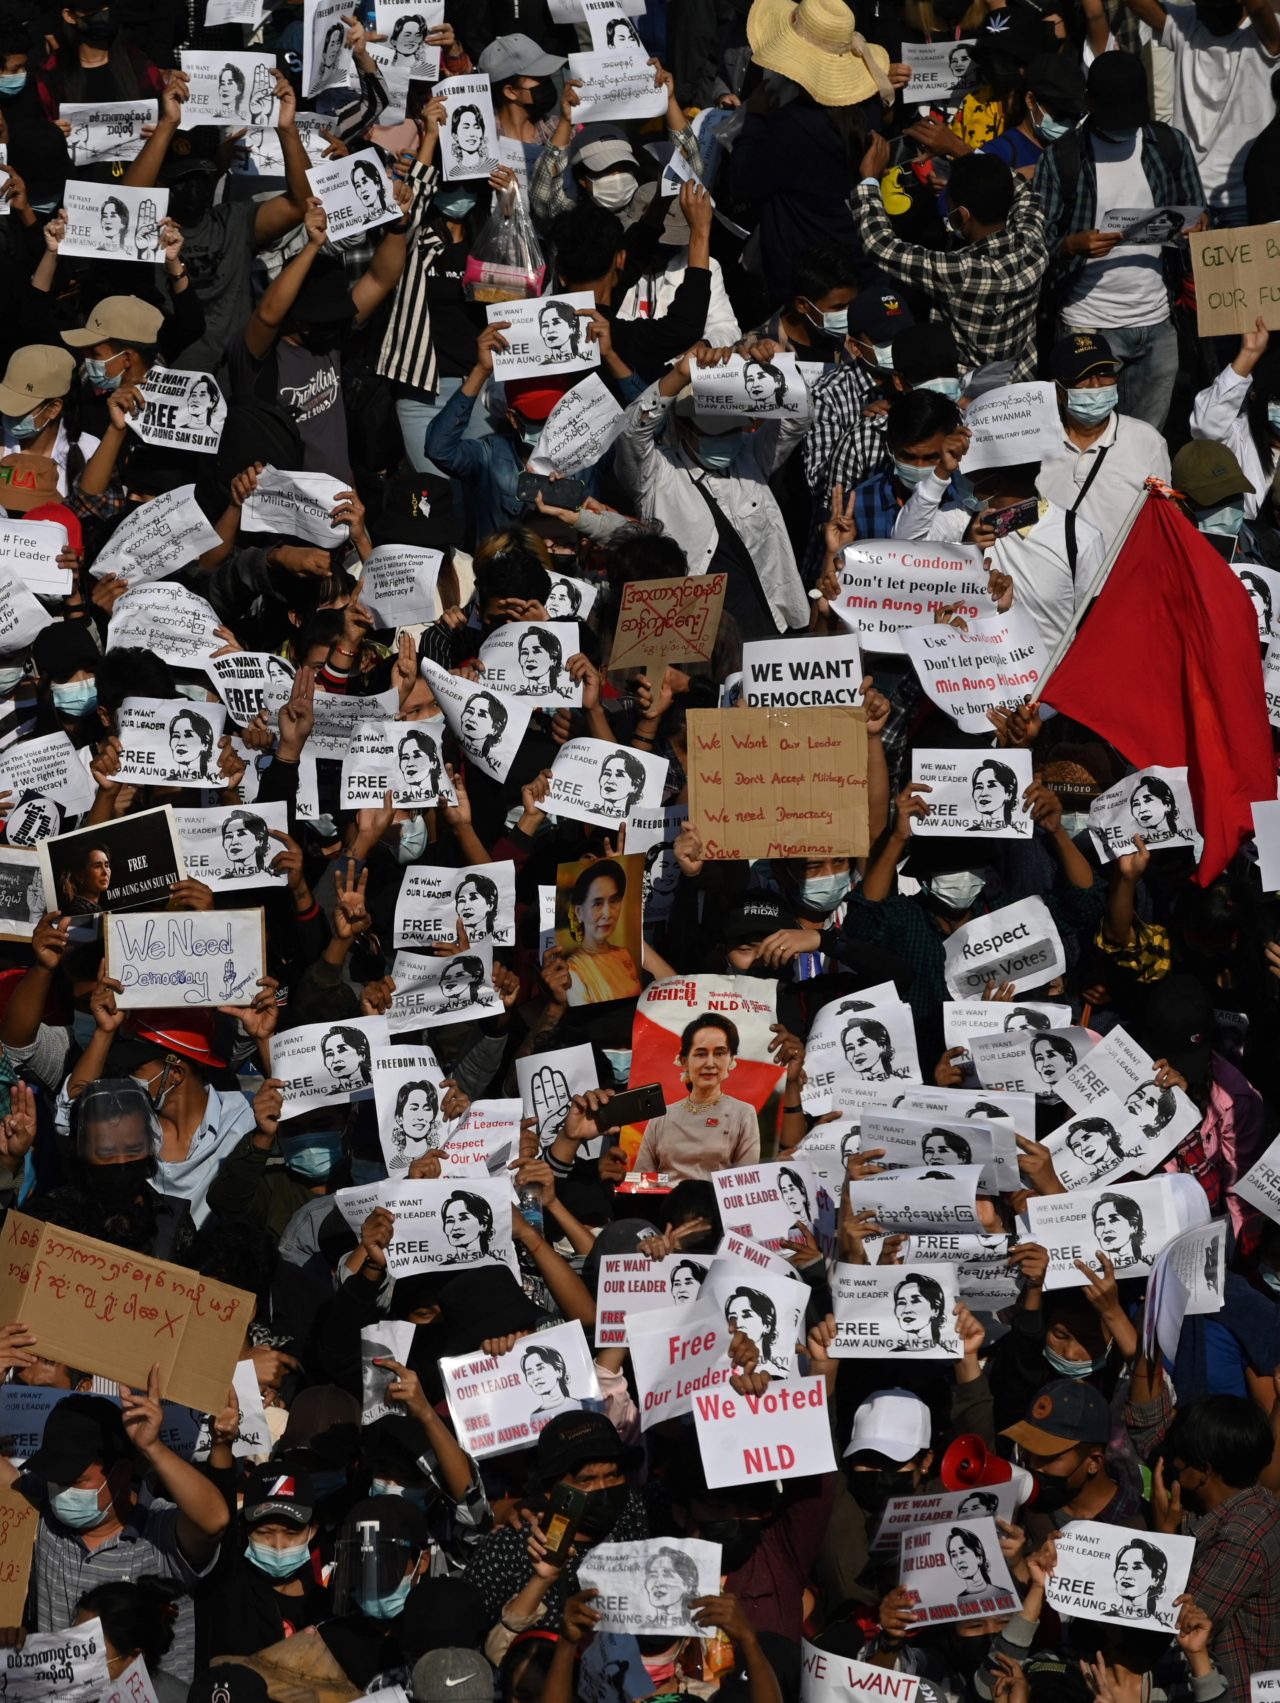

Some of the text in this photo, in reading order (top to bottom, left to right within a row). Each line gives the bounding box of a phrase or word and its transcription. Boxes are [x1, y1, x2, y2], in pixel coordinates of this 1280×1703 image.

[327, 206, 354, 224] FREE
[1202, 244, 1252, 267] GIVE
[971, 410, 1032, 427] SAVE MYANMAR
[260, 493, 301, 514] Military
[287, 489, 319, 505] Reject
[13, 534, 37, 548] Free
[15, 546, 50, 562] Leader
[843, 573, 988, 595] Don't let people like
[5, 608, 15, 621] for
[213, 657, 260, 672] WE WANT
[923, 655, 957, 671] Don't
[959, 654, 973, 667] let
[1009, 644, 1035, 663] like
[752, 659, 854, 682] WE WANT
[936, 679, 961, 694] Min
[963, 676, 996, 692] Aung
[748, 689, 857, 707] DEMOCRACY
[696, 734, 842, 751] We Want Our Leader
[348, 775, 387, 789] FREE
[700, 773, 722, 785] We
[735, 772, 765, 786] Don't
[771, 773, 806, 786] Accept
[704, 807, 832, 824] We need Democracy
[917, 819, 970, 828] DAW AUNG
[704, 840, 834, 859] Save Myanmar
[128, 855, 148, 872] FREE
[106, 889, 120, 901] DAW
[121, 885, 138, 898] AUNG
[139, 883, 151, 895] SAN
[744, 908, 779, 916] FRIDAY
[403, 919, 442, 931] FREE
[116, 919, 233, 961] We Need
[962, 922, 1030, 960] Respect
[966, 948, 1047, 988] Our Votes
[708, 1000, 739, 1012] NLD
[376, 1056, 426, 1070] FREEDOM TO
[443, 1139, 484, 1151] Respect
[917, 1236, 959, 1249] FREE
[390, 1253, 443, 1269] DAW AUNG
[604, 1280, 666, 1293] OUR LEADER
[835, 1323, 880, 1336] FREE
[669, 1330, 717, 1366] Free
[835, 1338, 894, 1348] DAW AUNG
[457, 1374, 521, 1401] OUR LEADER
[644, 1365, 740, 1412] Our Leaders
[696, 1380, 824, 1422] We Voted
[743, 1445, 795, 1474] NLD
[889, 1511, 954, 1523] OUR LEADER
[1056, 1543, 1111, 1560] OUR LEADER
[1048, 1576, 1095, 1596] FREE
[1047, 1591, 1107, 1612] DAW AUNG
